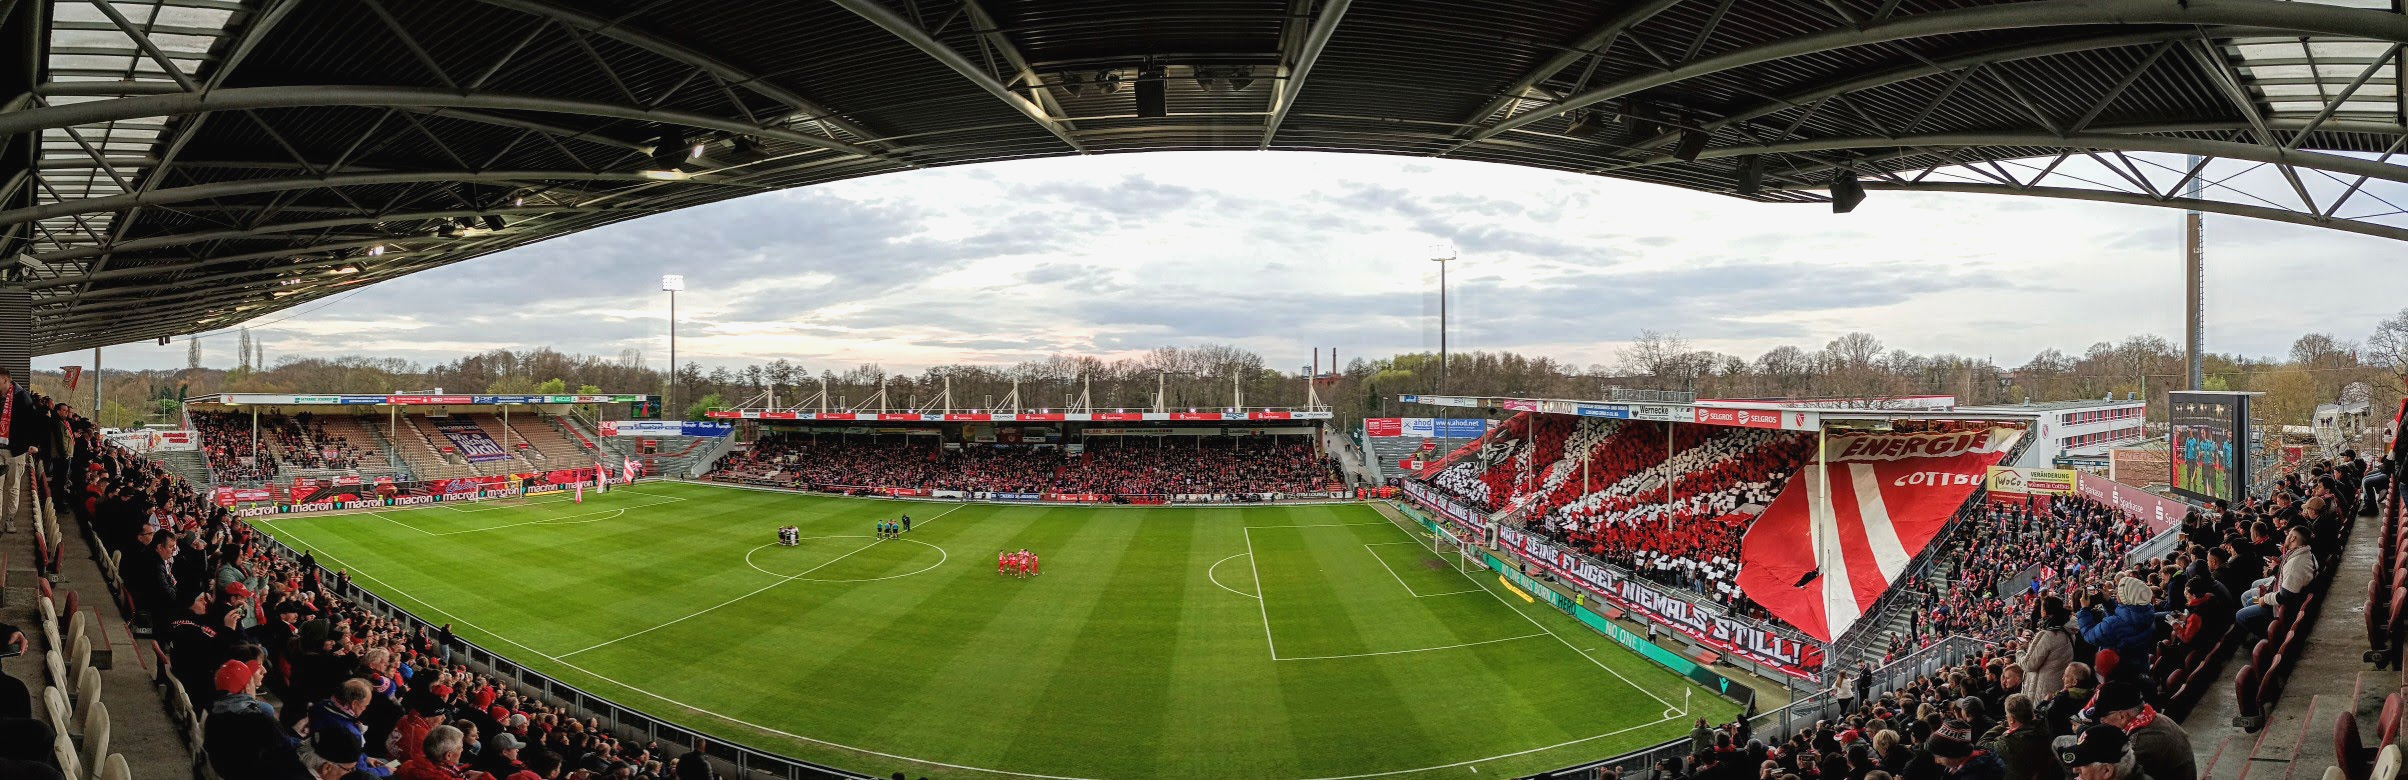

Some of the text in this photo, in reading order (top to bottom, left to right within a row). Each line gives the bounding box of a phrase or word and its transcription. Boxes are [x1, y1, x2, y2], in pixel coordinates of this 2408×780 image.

[1640, 405, 1669, 414] Wernecke
[1710, 412, 1733, 420] SELGROS
[1751, 415, 1777, 423] SELGROS
[1840, 430, 1990, 458] ENERGIE
[1893, 471, 1986, 487] COTTBU
[2031, 471, 2070, 479] VERÄNDERUNG
[239, 504, 279, 517] macron
[291, 502, 333, 512] macron
[345, 498, 385, 509] macron
[395, 494, 433, 506] macron
[443, 491, 478, 501] macron
[528, 484, 558, 493] macron
[565, 480, 593, 490] maron
[2084, 484, 2104, 499] Sparkasse
[2120, 497, 2143, 514] Sparkasse
[1501, 563, 1509, 575] NO
[1509, 567, 1520, 583] ONE
[1520, 574, 1534, 592] WAS
[1534, 581, 1551, 602] BORN
[1551, 594, 1557, 605] A
[1525, 537, 1559, 566] SEINE
[1562, 554, 1617, 593] FLÜGEL
[1622, 581, 1709, 633] NIEMALS
[1712, 616, 1802, 665] STILL!
[1605, 620, 1617, 639] NO
[1619, 627, 1638, 649] ONE
